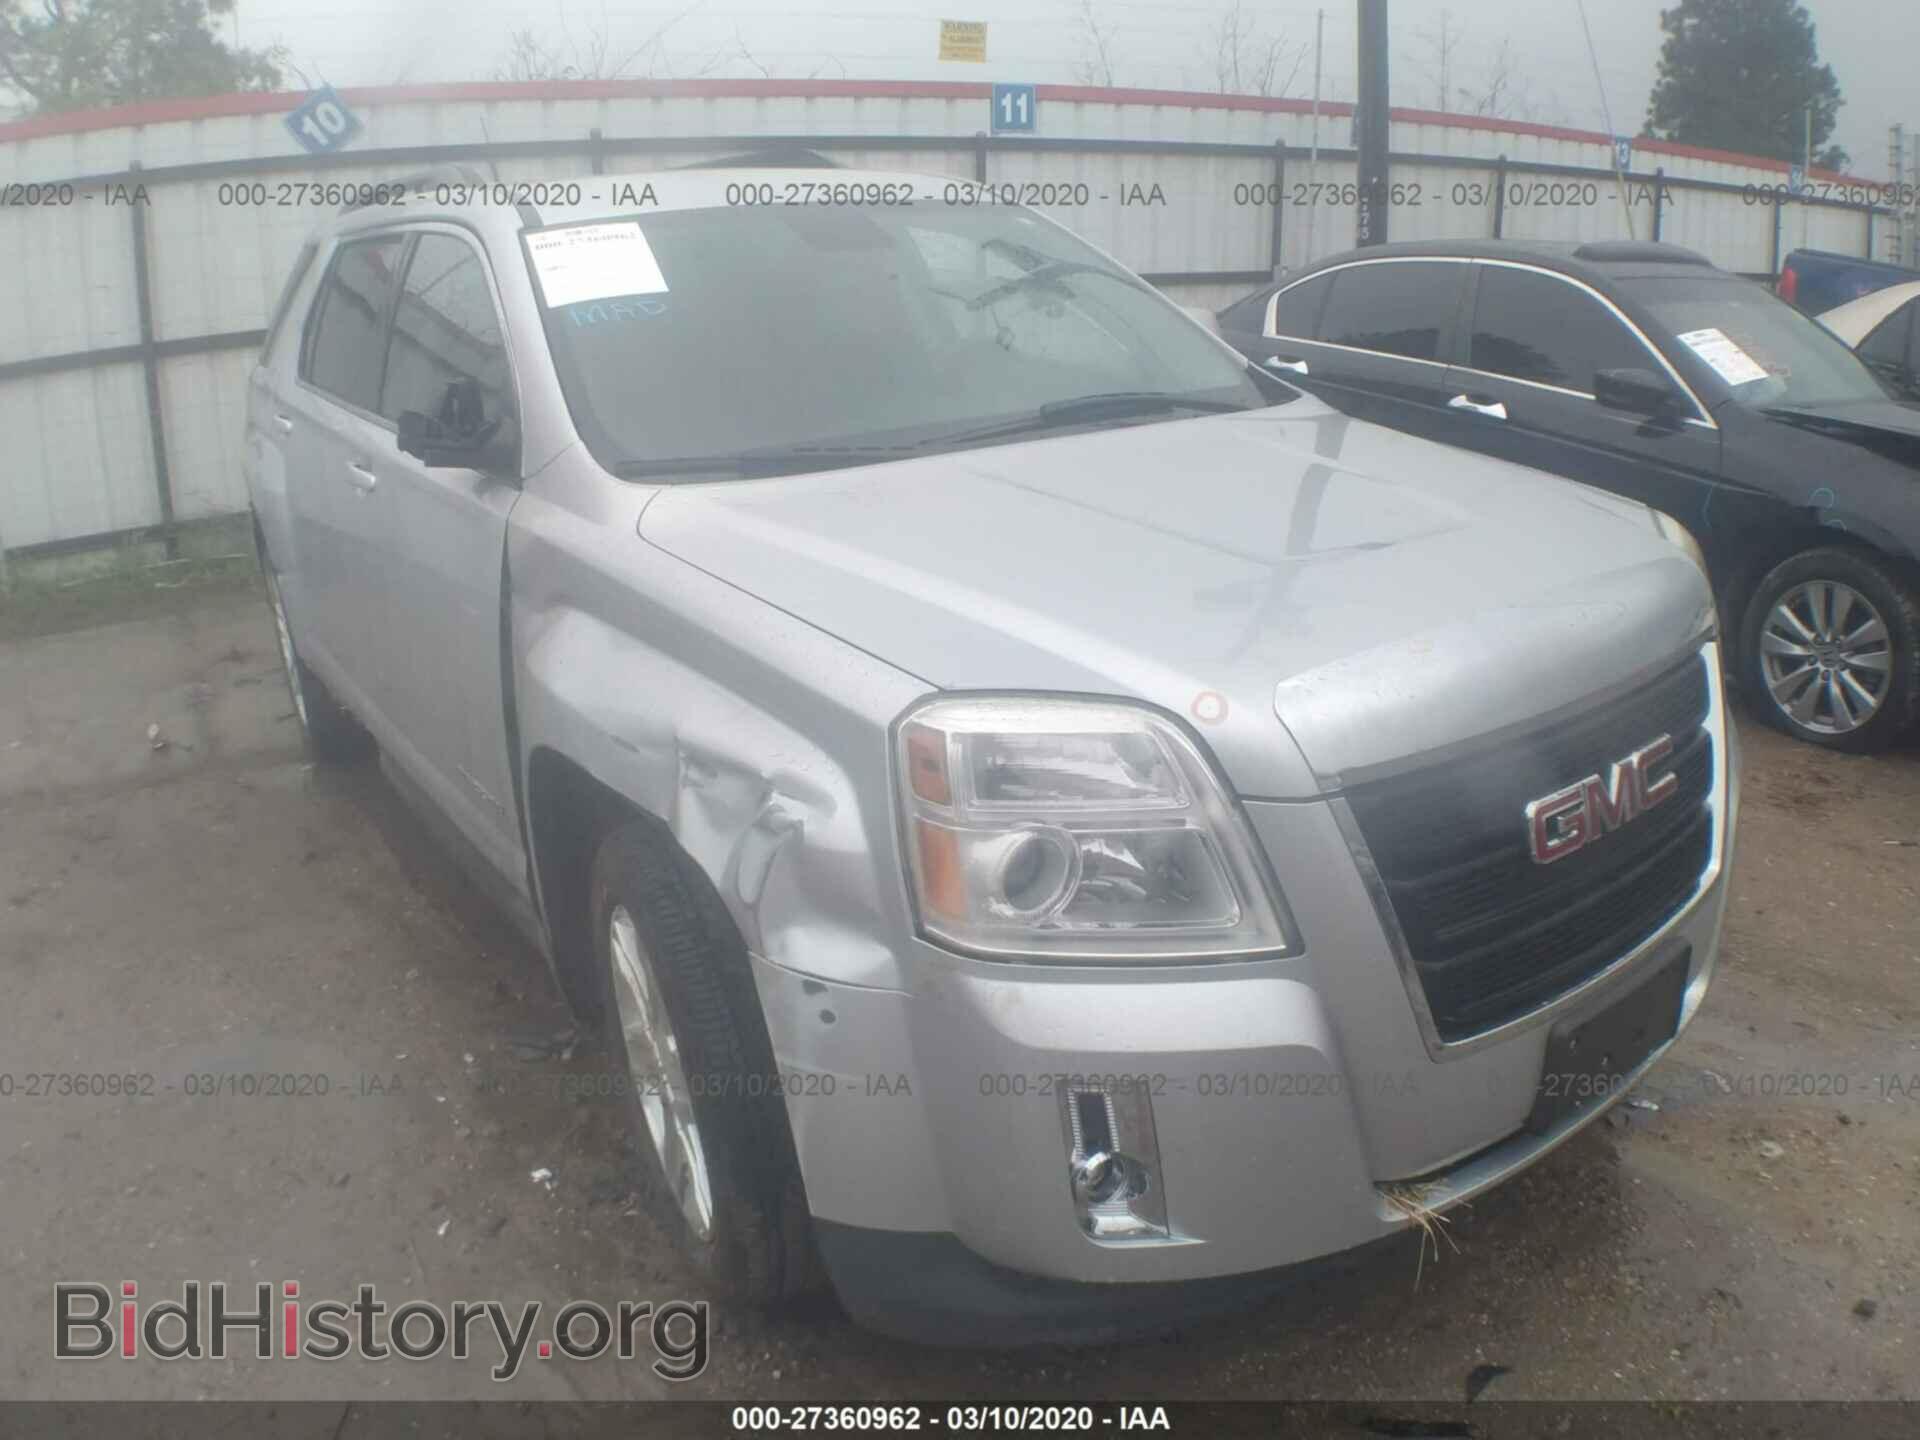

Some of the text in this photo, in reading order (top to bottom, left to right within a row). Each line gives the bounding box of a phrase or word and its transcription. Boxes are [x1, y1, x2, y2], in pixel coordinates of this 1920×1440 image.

[303, 101, 345, 147] 10
[1001, 93, 1027, 123] 11
[1525, 732, 1680, 864] GMC
